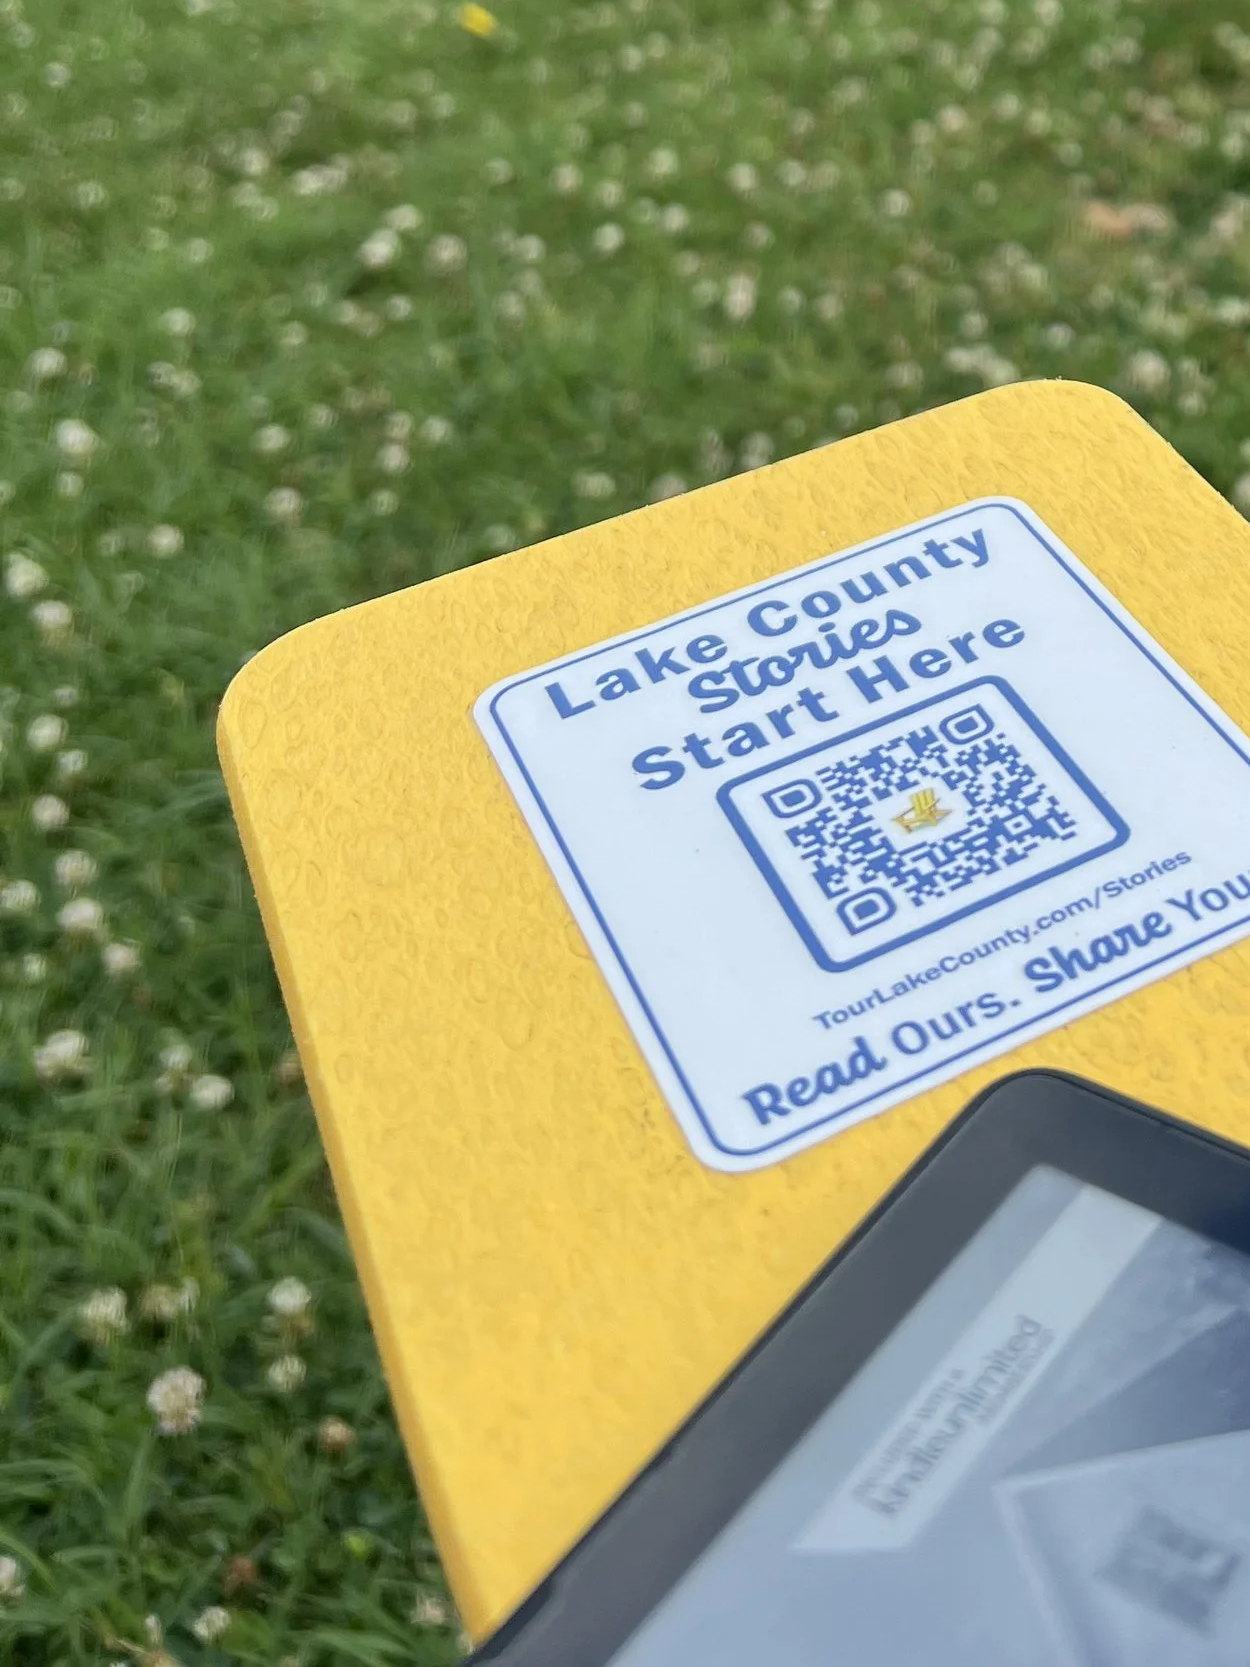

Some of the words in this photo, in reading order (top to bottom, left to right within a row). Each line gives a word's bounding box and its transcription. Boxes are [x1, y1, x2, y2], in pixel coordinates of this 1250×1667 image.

[545, 634, 728, 720] Lake
[746, 528, 990, 639] County
[631, 688, 840, 791] Start
[847, 618, 1026, 704] Here
[687, 608, 923, 714] Stories
[742, 1035, 888, 1126] Read
[890, 990, 1022, 1056] Ours.
[1023, 908, 1174, 994] Share
[813, 849, 1192, 1030] TourLakeCounty.com/Stories
